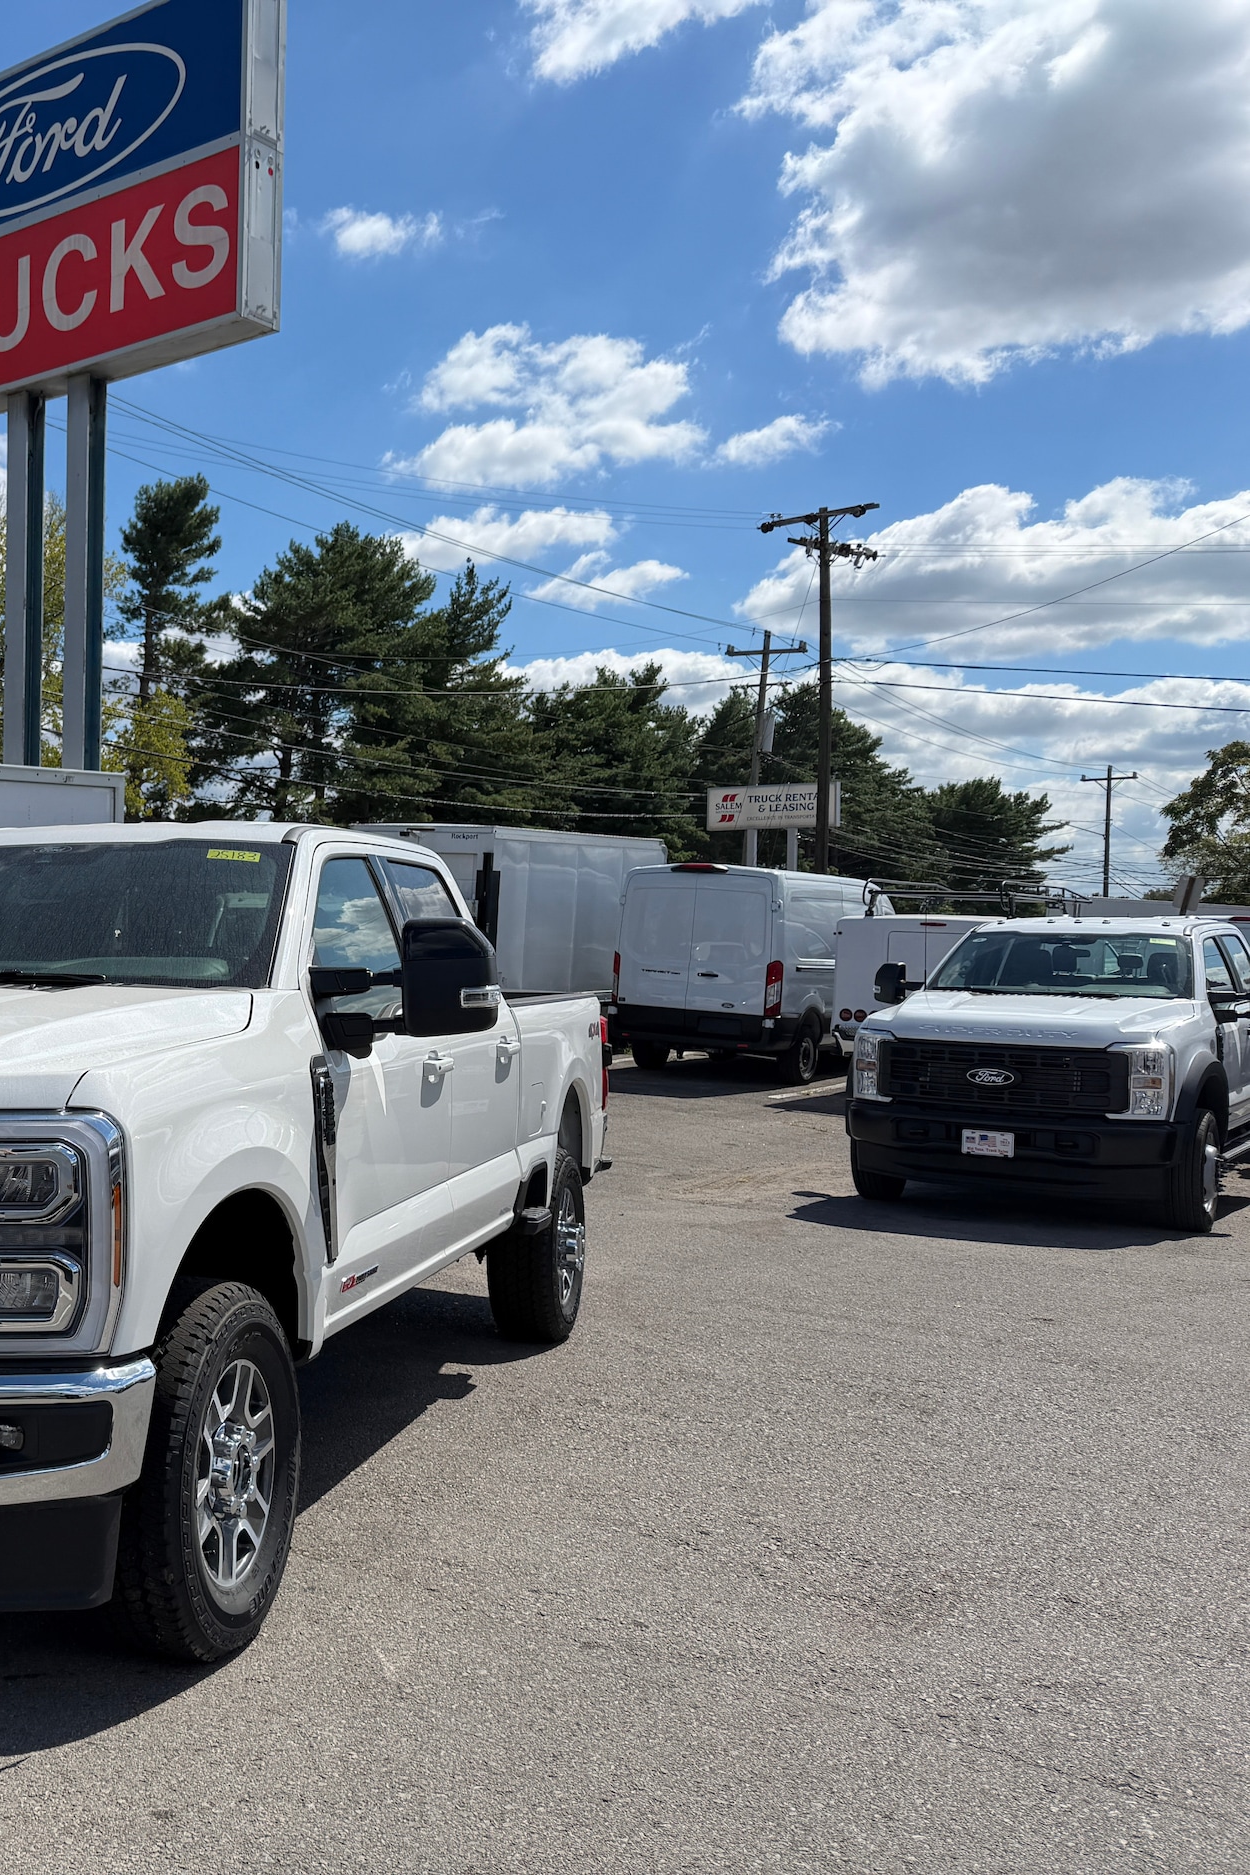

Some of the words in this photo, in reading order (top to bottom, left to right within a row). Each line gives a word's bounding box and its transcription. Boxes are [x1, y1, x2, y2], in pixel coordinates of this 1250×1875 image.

[747, 793, 782, 804] TRUCK
[784, 792, 818, 802] RENTA
[715, 802, 742, 810] SALEM
[758, 804, 765, 812] &
[769, 802, 814, 812] LEASING
[451, 832, 479, 841] Rockport
[210, 850, 257, 861] 25183
[918, 1023, 1001, 1036] SUPER
[1005, 1027, 1079, 1039] DUTY
[975, 1070, 1004, 1083] Ford
